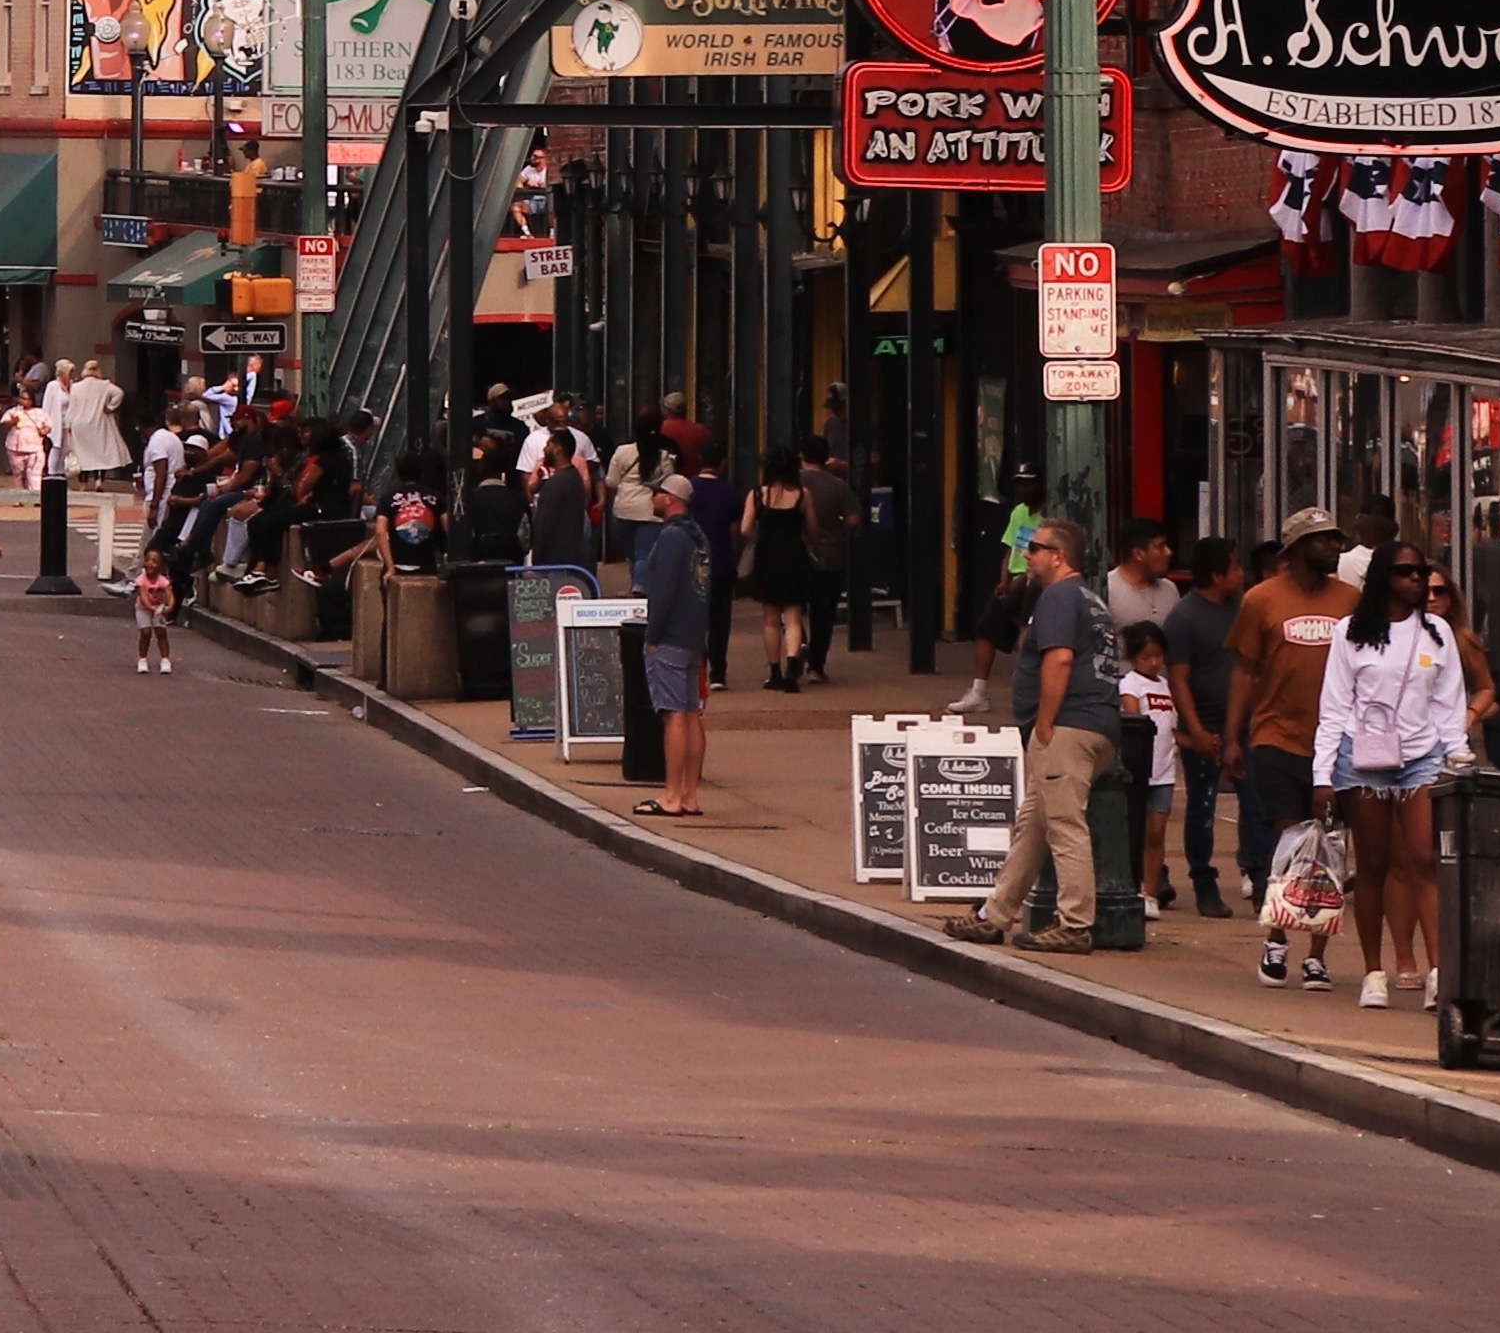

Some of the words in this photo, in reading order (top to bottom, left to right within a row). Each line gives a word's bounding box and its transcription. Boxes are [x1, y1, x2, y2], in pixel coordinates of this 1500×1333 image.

[666, 34, 733, 49] WORLD
[763, 33, 844, 49] FAMOUS
[293, 41, 412, 58] SUTHERN
[705, 52, 755, 67] IRISH
[766, 52, 804, 67] BAR
[334, 65, 365, 80] 183
[863, 91, 985, 119] PORK
[1000, 91, 1111, 119] WH
[1265, 89, 1459, 128] ESTABLISHED
[271, 103, 398, 133] FOD-MUS
[865, 131, 916, 162] AN
[926, 131, 1114, 163] ATTITU
[304, 241, 328, 253] NO
[530, 249, 570, 264] STREE
[540, 263, 570, 277] BAR
[1055, 252, 1100, 276] NO
[1047, 287, 1105, 302] PARKING
[1047, 308, 1109, 321] STANDING
[225, 333, 249, 344] ONE
[252, 333, 278, 344] WAY
[873, 338, 946, 355] AT
[1050, 369, 1113, 379] TOW-AWAY
[1066, 382, 1099, 392] ZONE
[575, 609, 596, 618] BUD
[597, 609, 628, 618] LIGHT
[919, 783, 962, 795] COME
[964, 783, 1012, 795] INSIDE
[952, 809, 969, 820] Ice
[970, 809, 1006, 820] Cream
[924, 822, 967, 835] Coffee
[928, 844, 963, 857] Beer
[968, 857, 1005, 869] Wine
